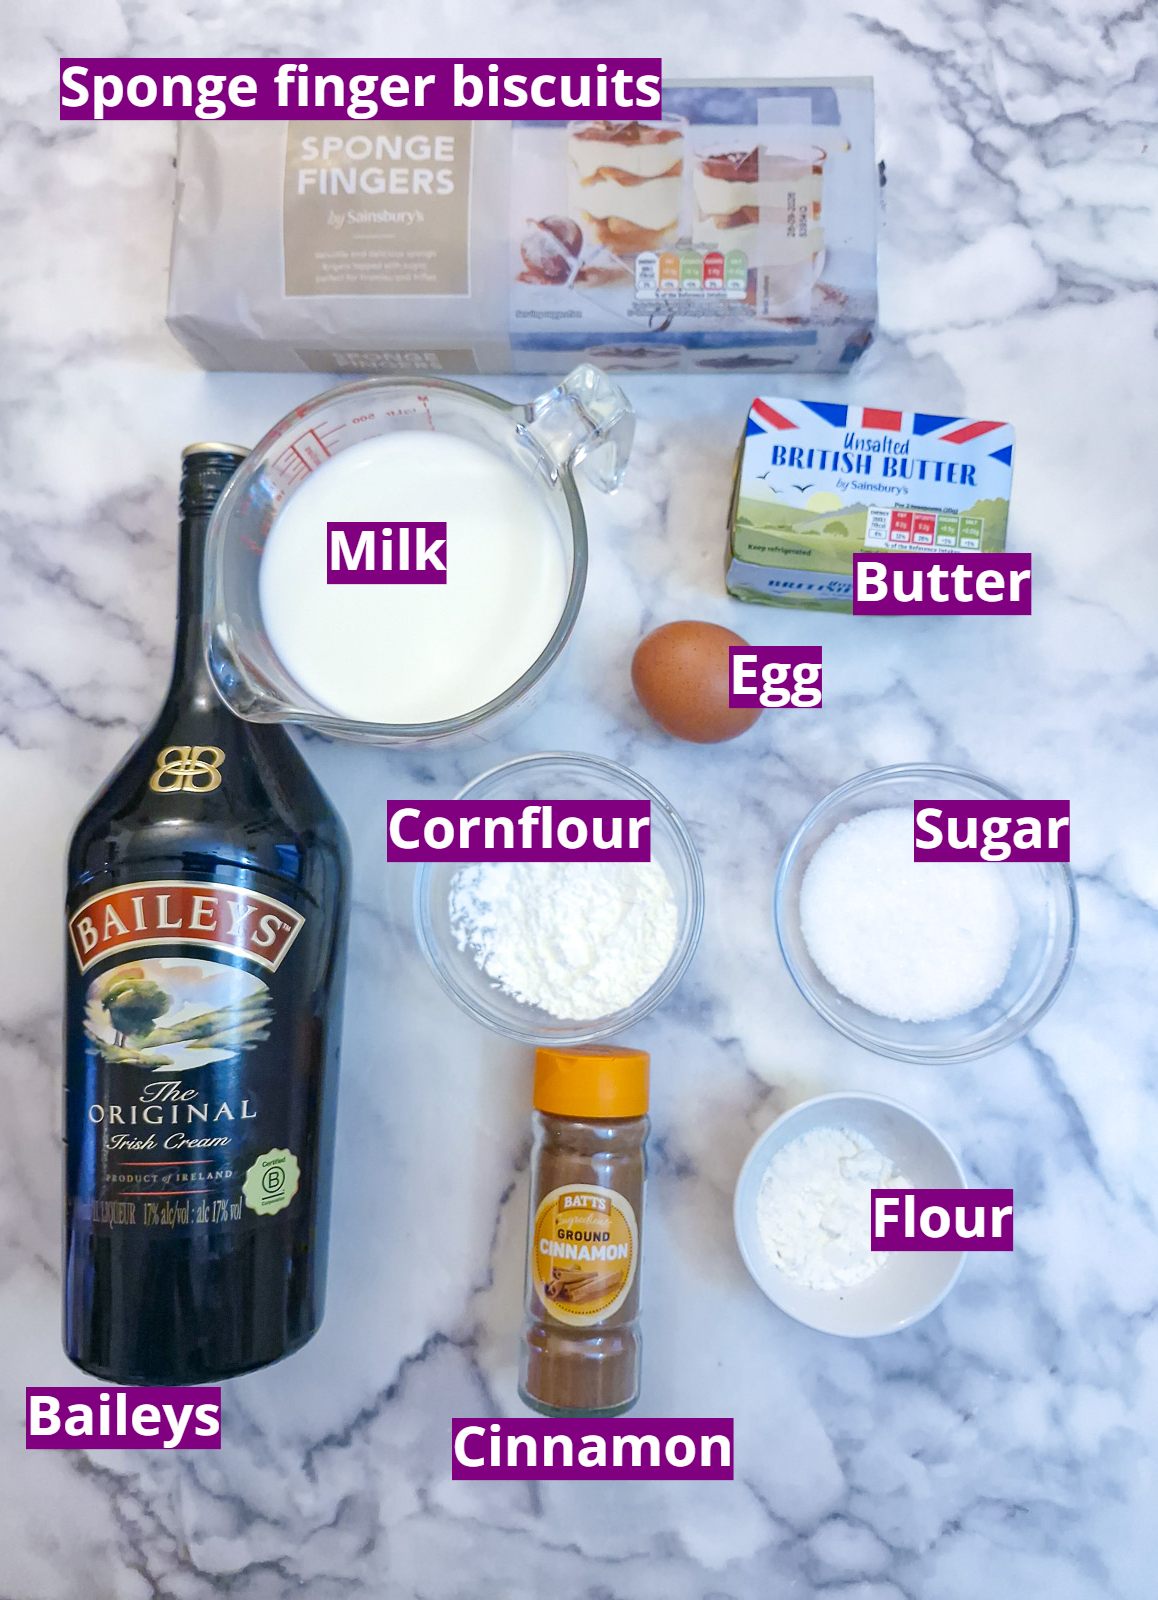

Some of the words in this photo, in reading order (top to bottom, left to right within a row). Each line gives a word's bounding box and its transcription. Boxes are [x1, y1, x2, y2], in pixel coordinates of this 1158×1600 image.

[301, 135, 455, 162] SPONGE
[298, 167, 455, 195] FINGERS
[327, 210, 344, 229] by
[347, 209, 424, 225] Sainsbury's
[843, 432, 910, 455] Unsalted
[771, 445, 872, 475] BRITISH
[882, 457, 978, 487] BUTTER
[836, 478, 850, 492] by
[851, 480, 909, 495] Sainsbury's
[75, 893, 282, 955] BAILEYS
[139, 1080, 199, 1104] The
[88, 1100, 257, 1124] ORIGINAL
[106, 1133, 157, 1152] Irish
[164, 1132, 232, 1150] Cream
[106, 1174, 158, 1183] PRODUCT
[162, 1174, 171, 1184] of
[176, 1170, 234, 1182] IRELAND
[143, 1203, 160, 1226] 17%
[161, 1201, 190, 1230] alc/vol
[196, 1200, 210, 1224] alc
[211, 1200, 228, 1222] 17%
[230, 1196, 243, 1220] vol
[564, 1195, 607, 1210] BATTS
[557, 1229, 610, 1242] GROUND
[540, 1239, 628, 1261] CINNAMON
